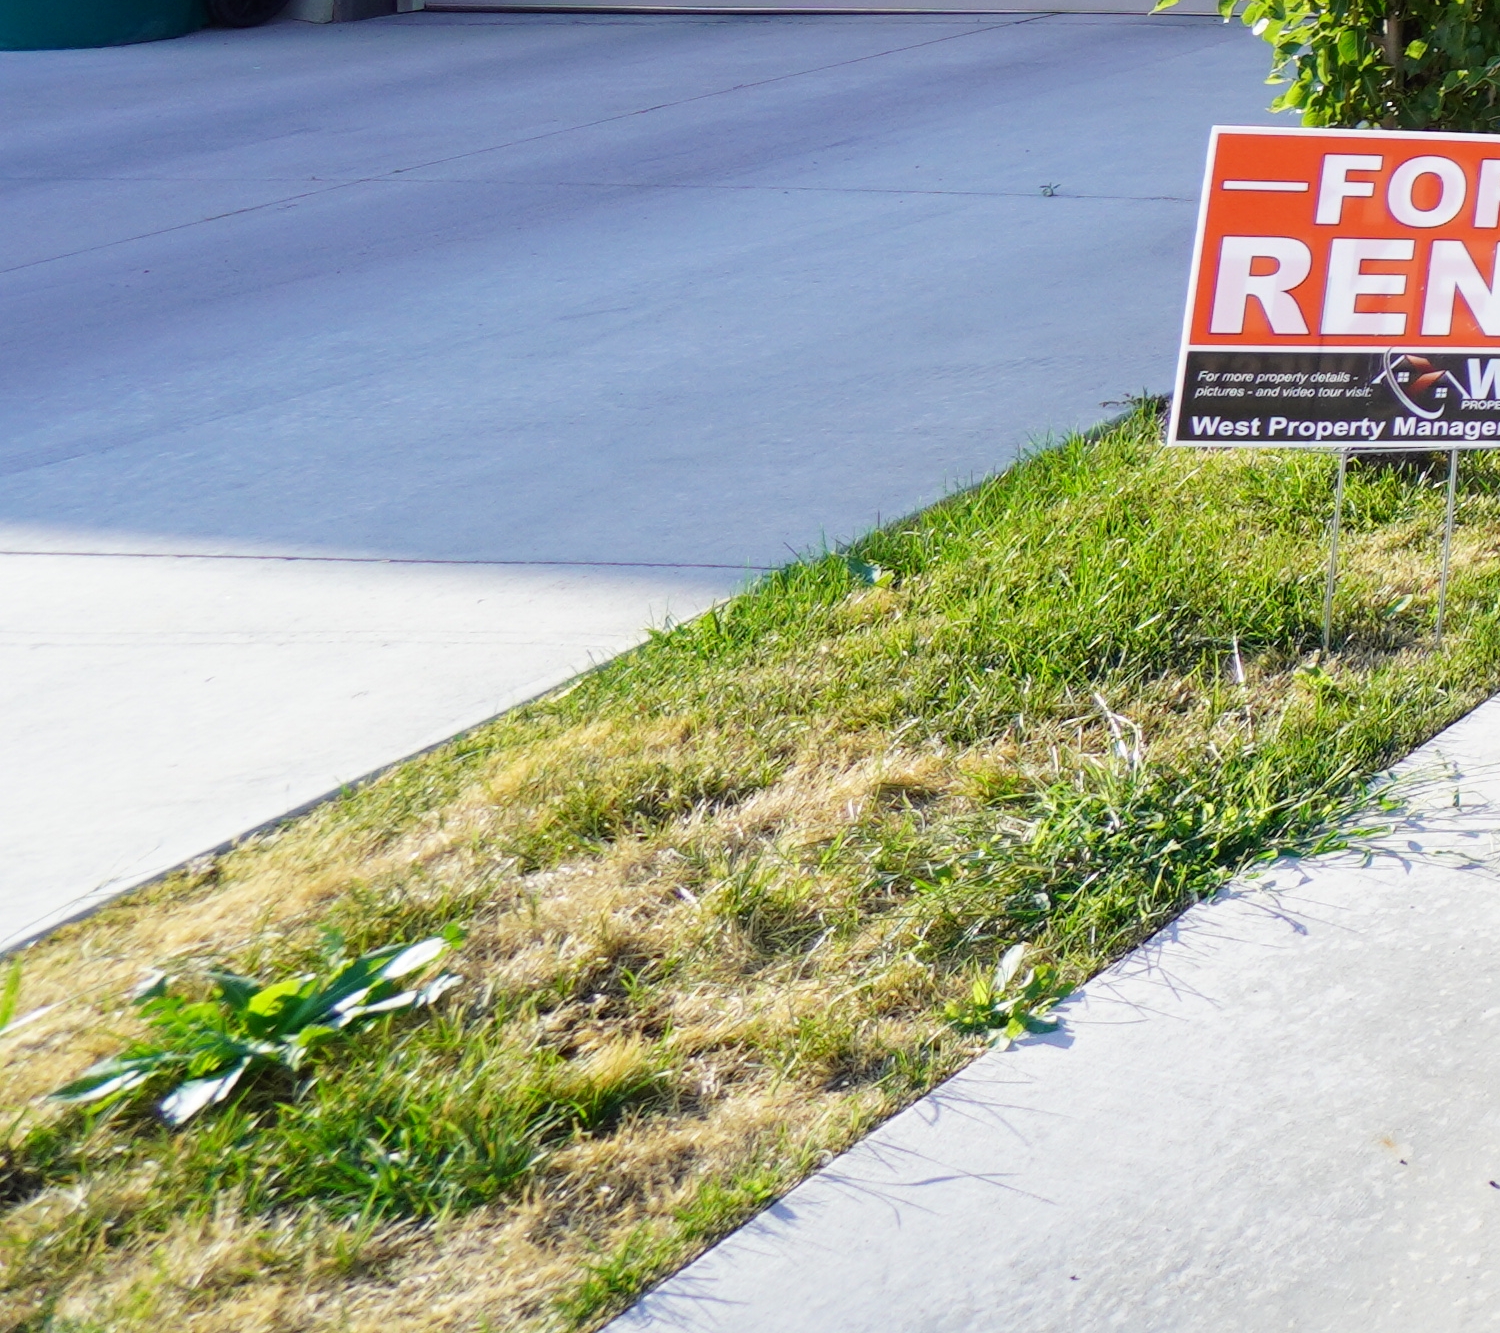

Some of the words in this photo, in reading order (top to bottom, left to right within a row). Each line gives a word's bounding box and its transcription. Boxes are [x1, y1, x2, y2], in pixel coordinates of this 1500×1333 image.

[1197, 370, 1219, 383] For
[1221, 372, 1253, 383] more
[1255, 371, 1308, 386] property
[1310, 371, 1351, 383] details
[1194, 385, 1245, 399] pictures
[1255, 386, 1281, 398] and
[1282, 386, 1315, 398] video
[1317, 387, 1344, 398] tour
[1345, 386, 1374, 398] visit:
[1191, 415, 1262, 437] West
[1268, 416, 1387, 441] Property
